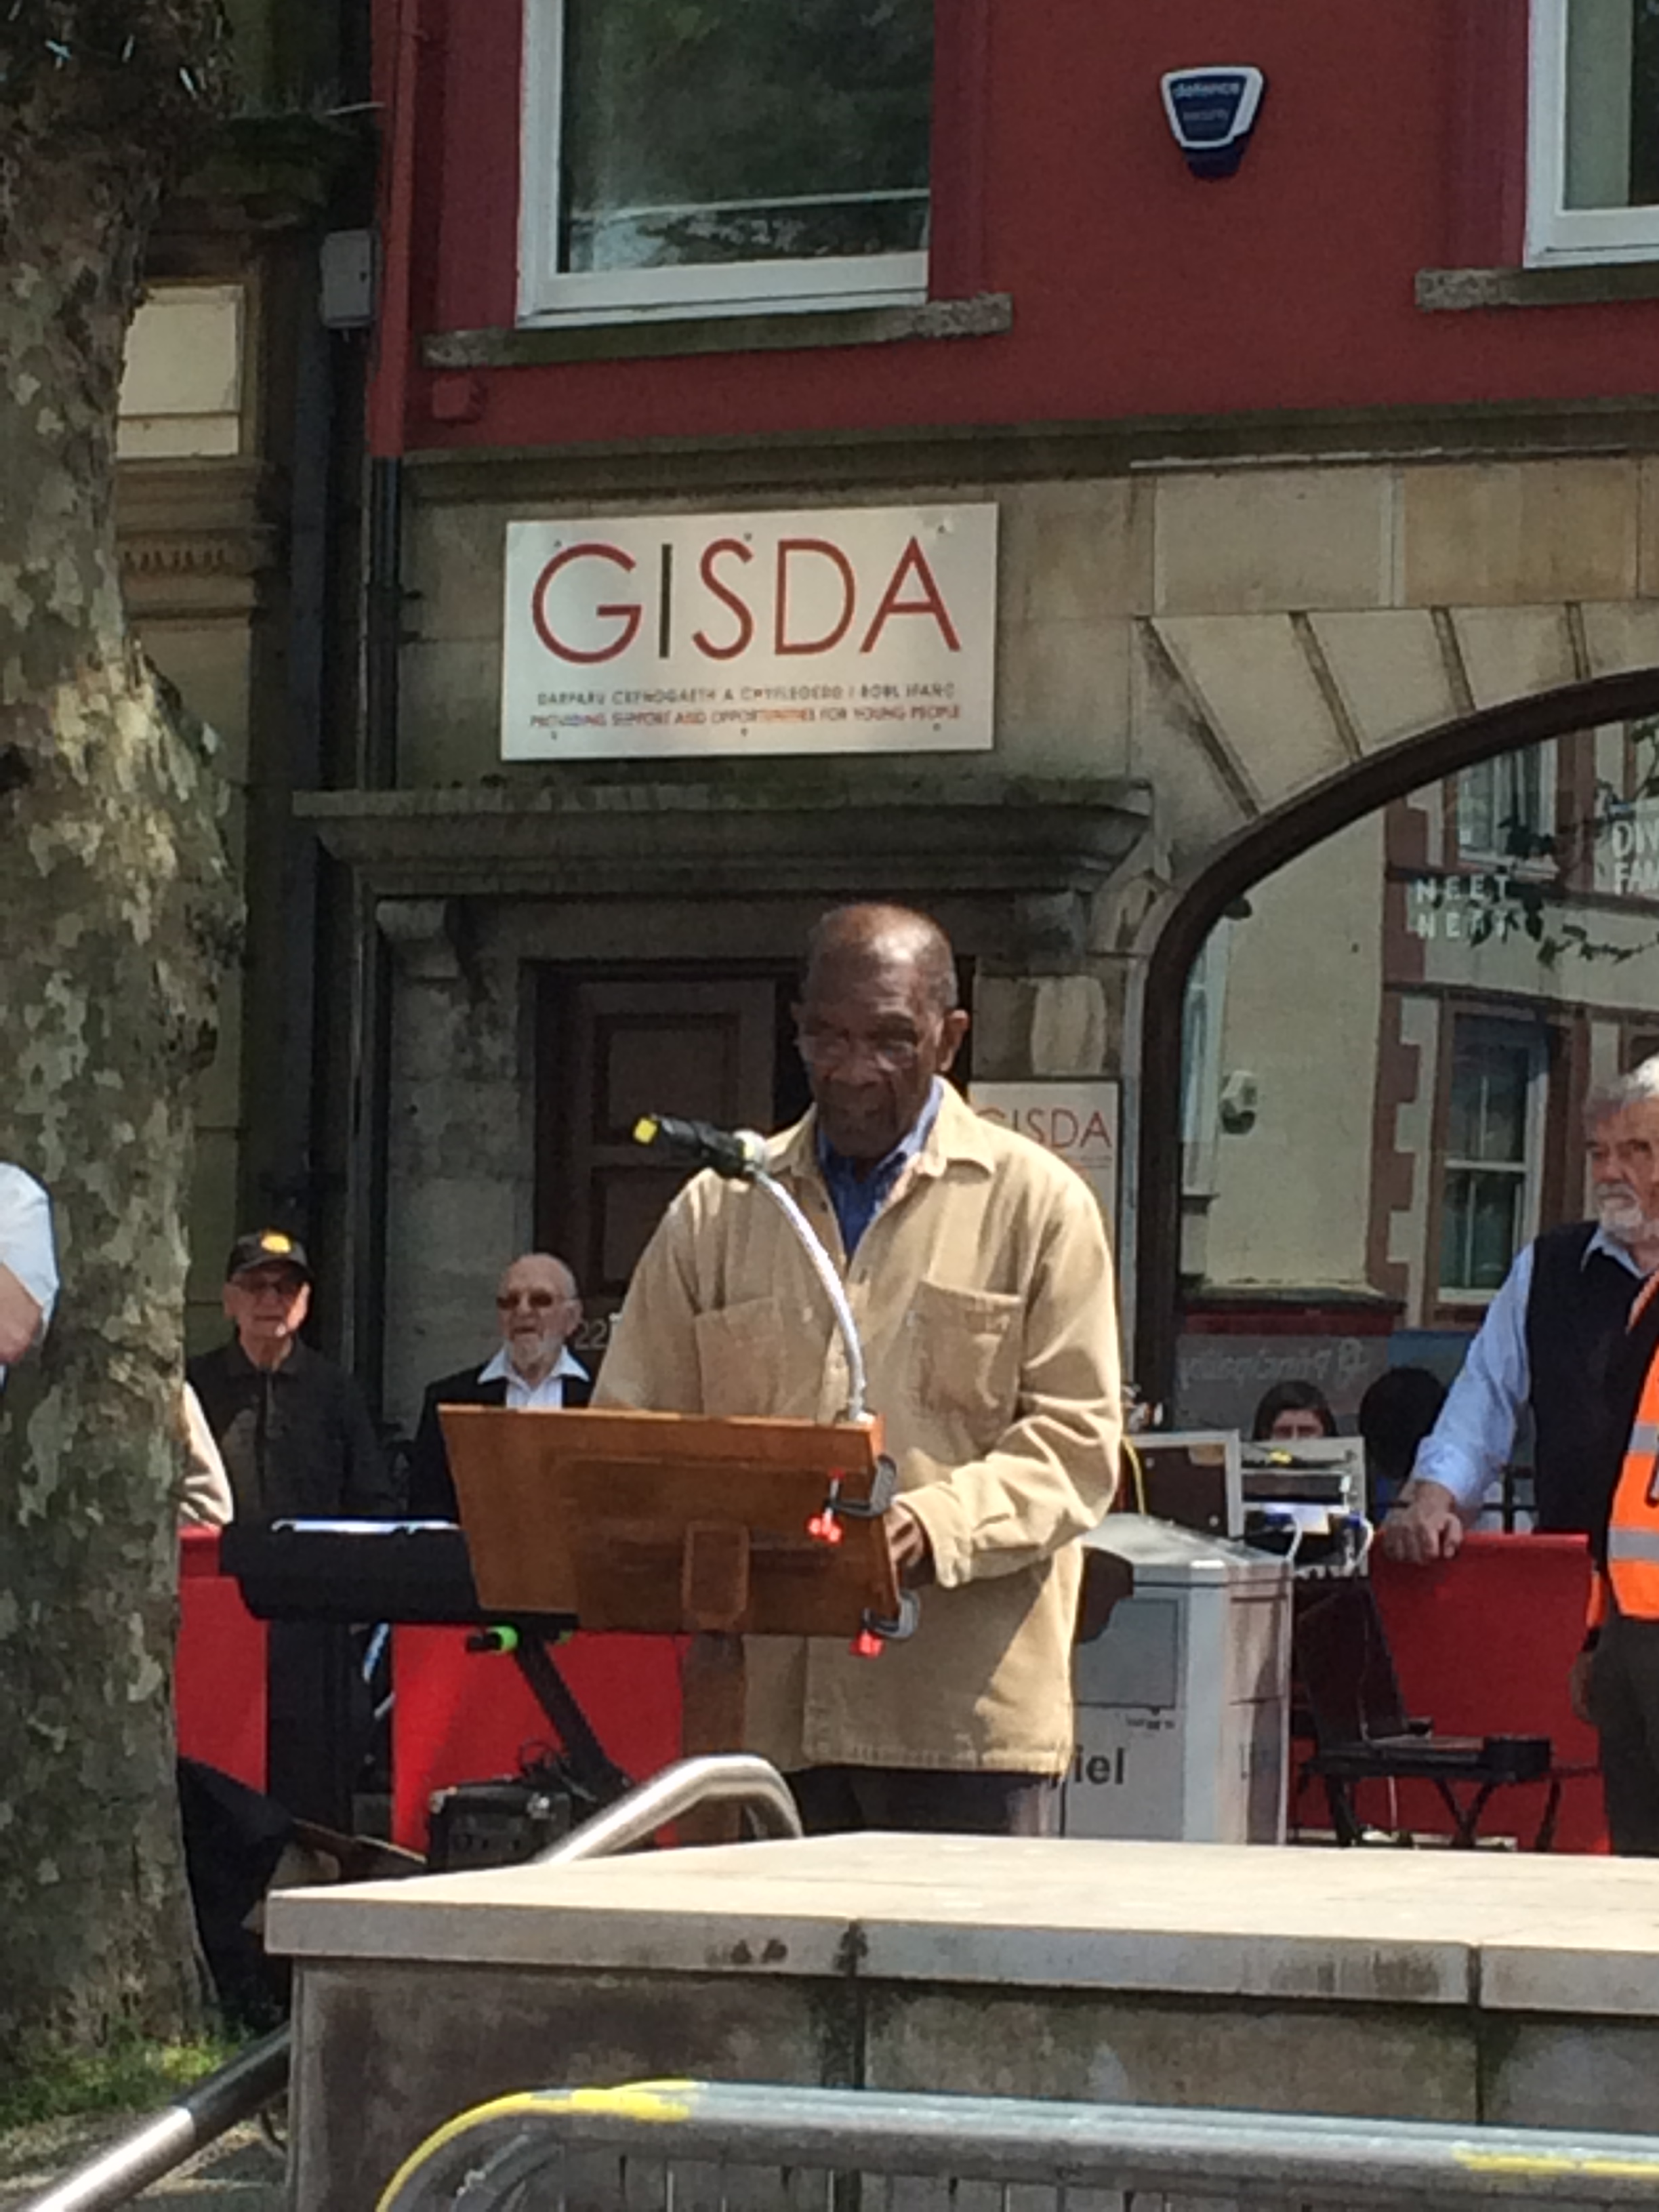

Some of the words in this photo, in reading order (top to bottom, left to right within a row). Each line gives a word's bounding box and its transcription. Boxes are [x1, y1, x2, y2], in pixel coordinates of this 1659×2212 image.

[533, 535, 960, 663] GISDA
[675, 710, 707, 724] AND
[820, 707, 847, 721] FOR
[854, 705, 906, 721] YOUNG
[911, 704, 960, 720] PEOPLE
[724, 687, 734, 701] A
[976, 1107, 1112, 1148] ISDA
[1074, 1744, 1123, 1785] iel
